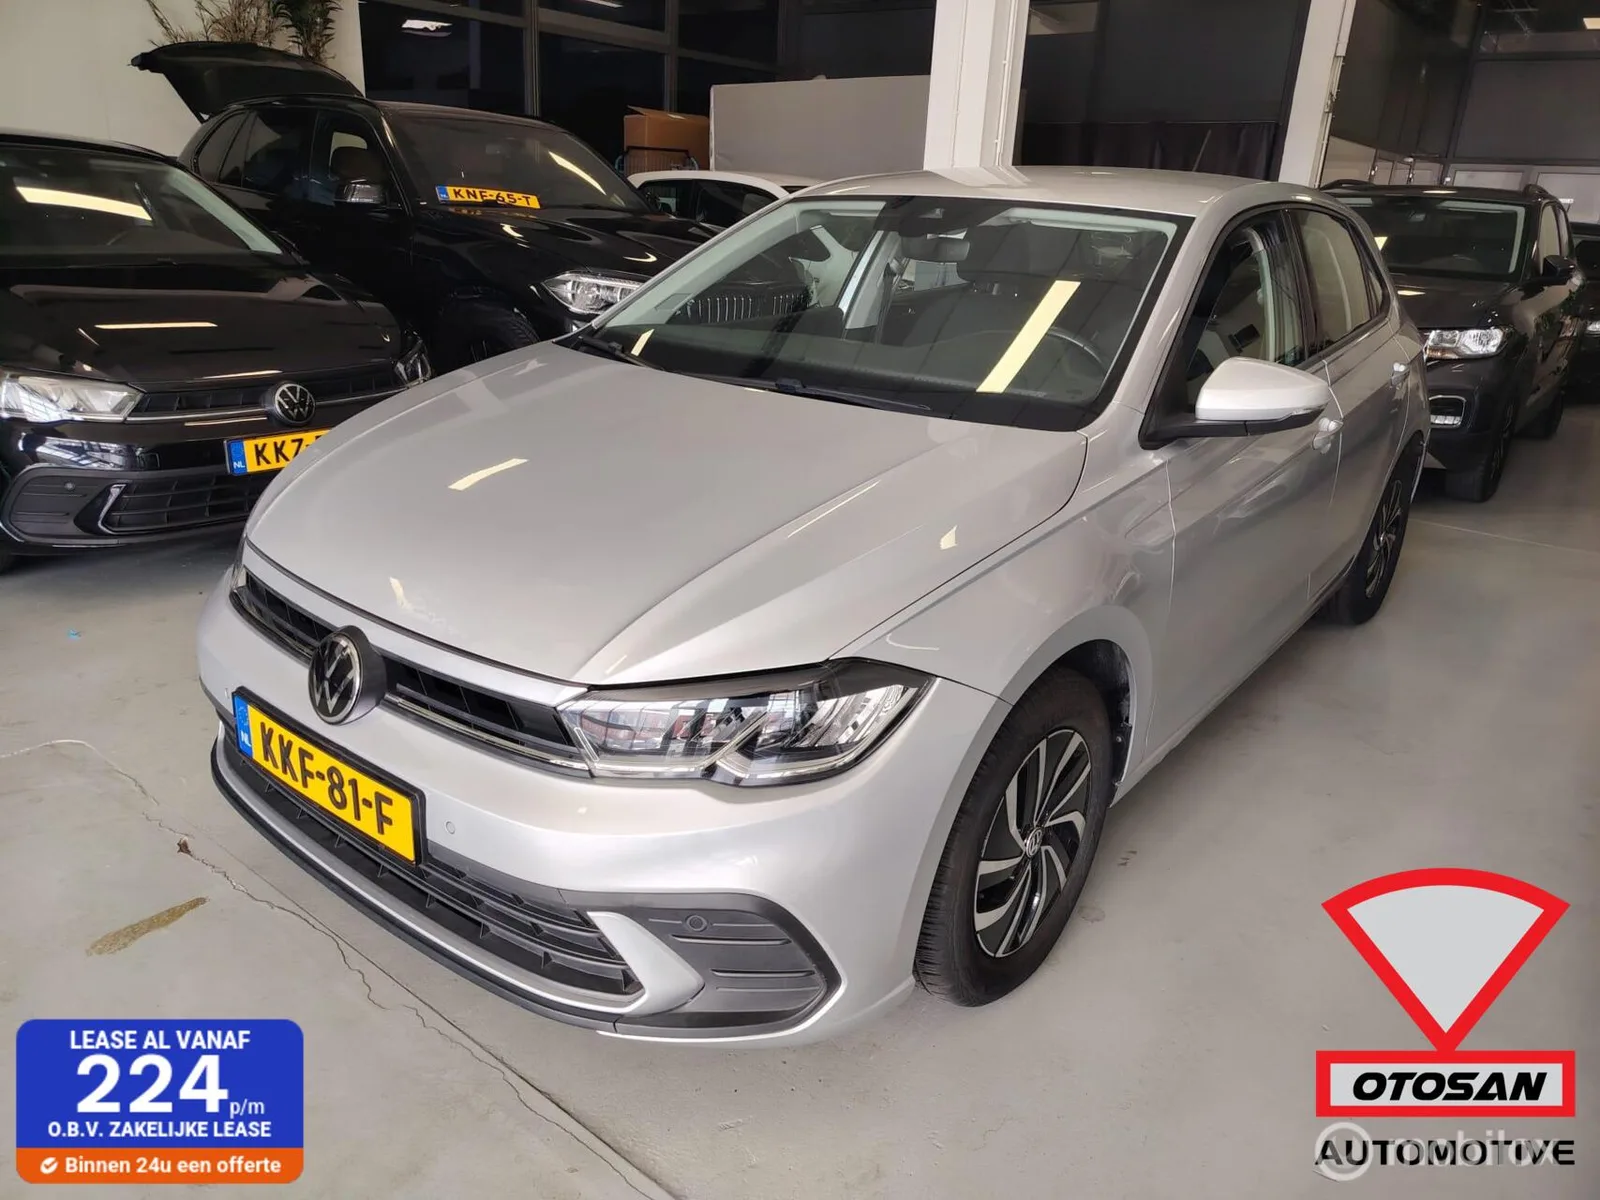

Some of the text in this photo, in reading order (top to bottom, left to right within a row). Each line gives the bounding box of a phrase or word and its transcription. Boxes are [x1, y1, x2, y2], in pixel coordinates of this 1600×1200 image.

[452, 188, 531, 206] KNF-65-T
[233, 461, 246, 469] NL
[240, 730, 252, 748] NL
[260, 721, 394, 836] KKF-81-F
